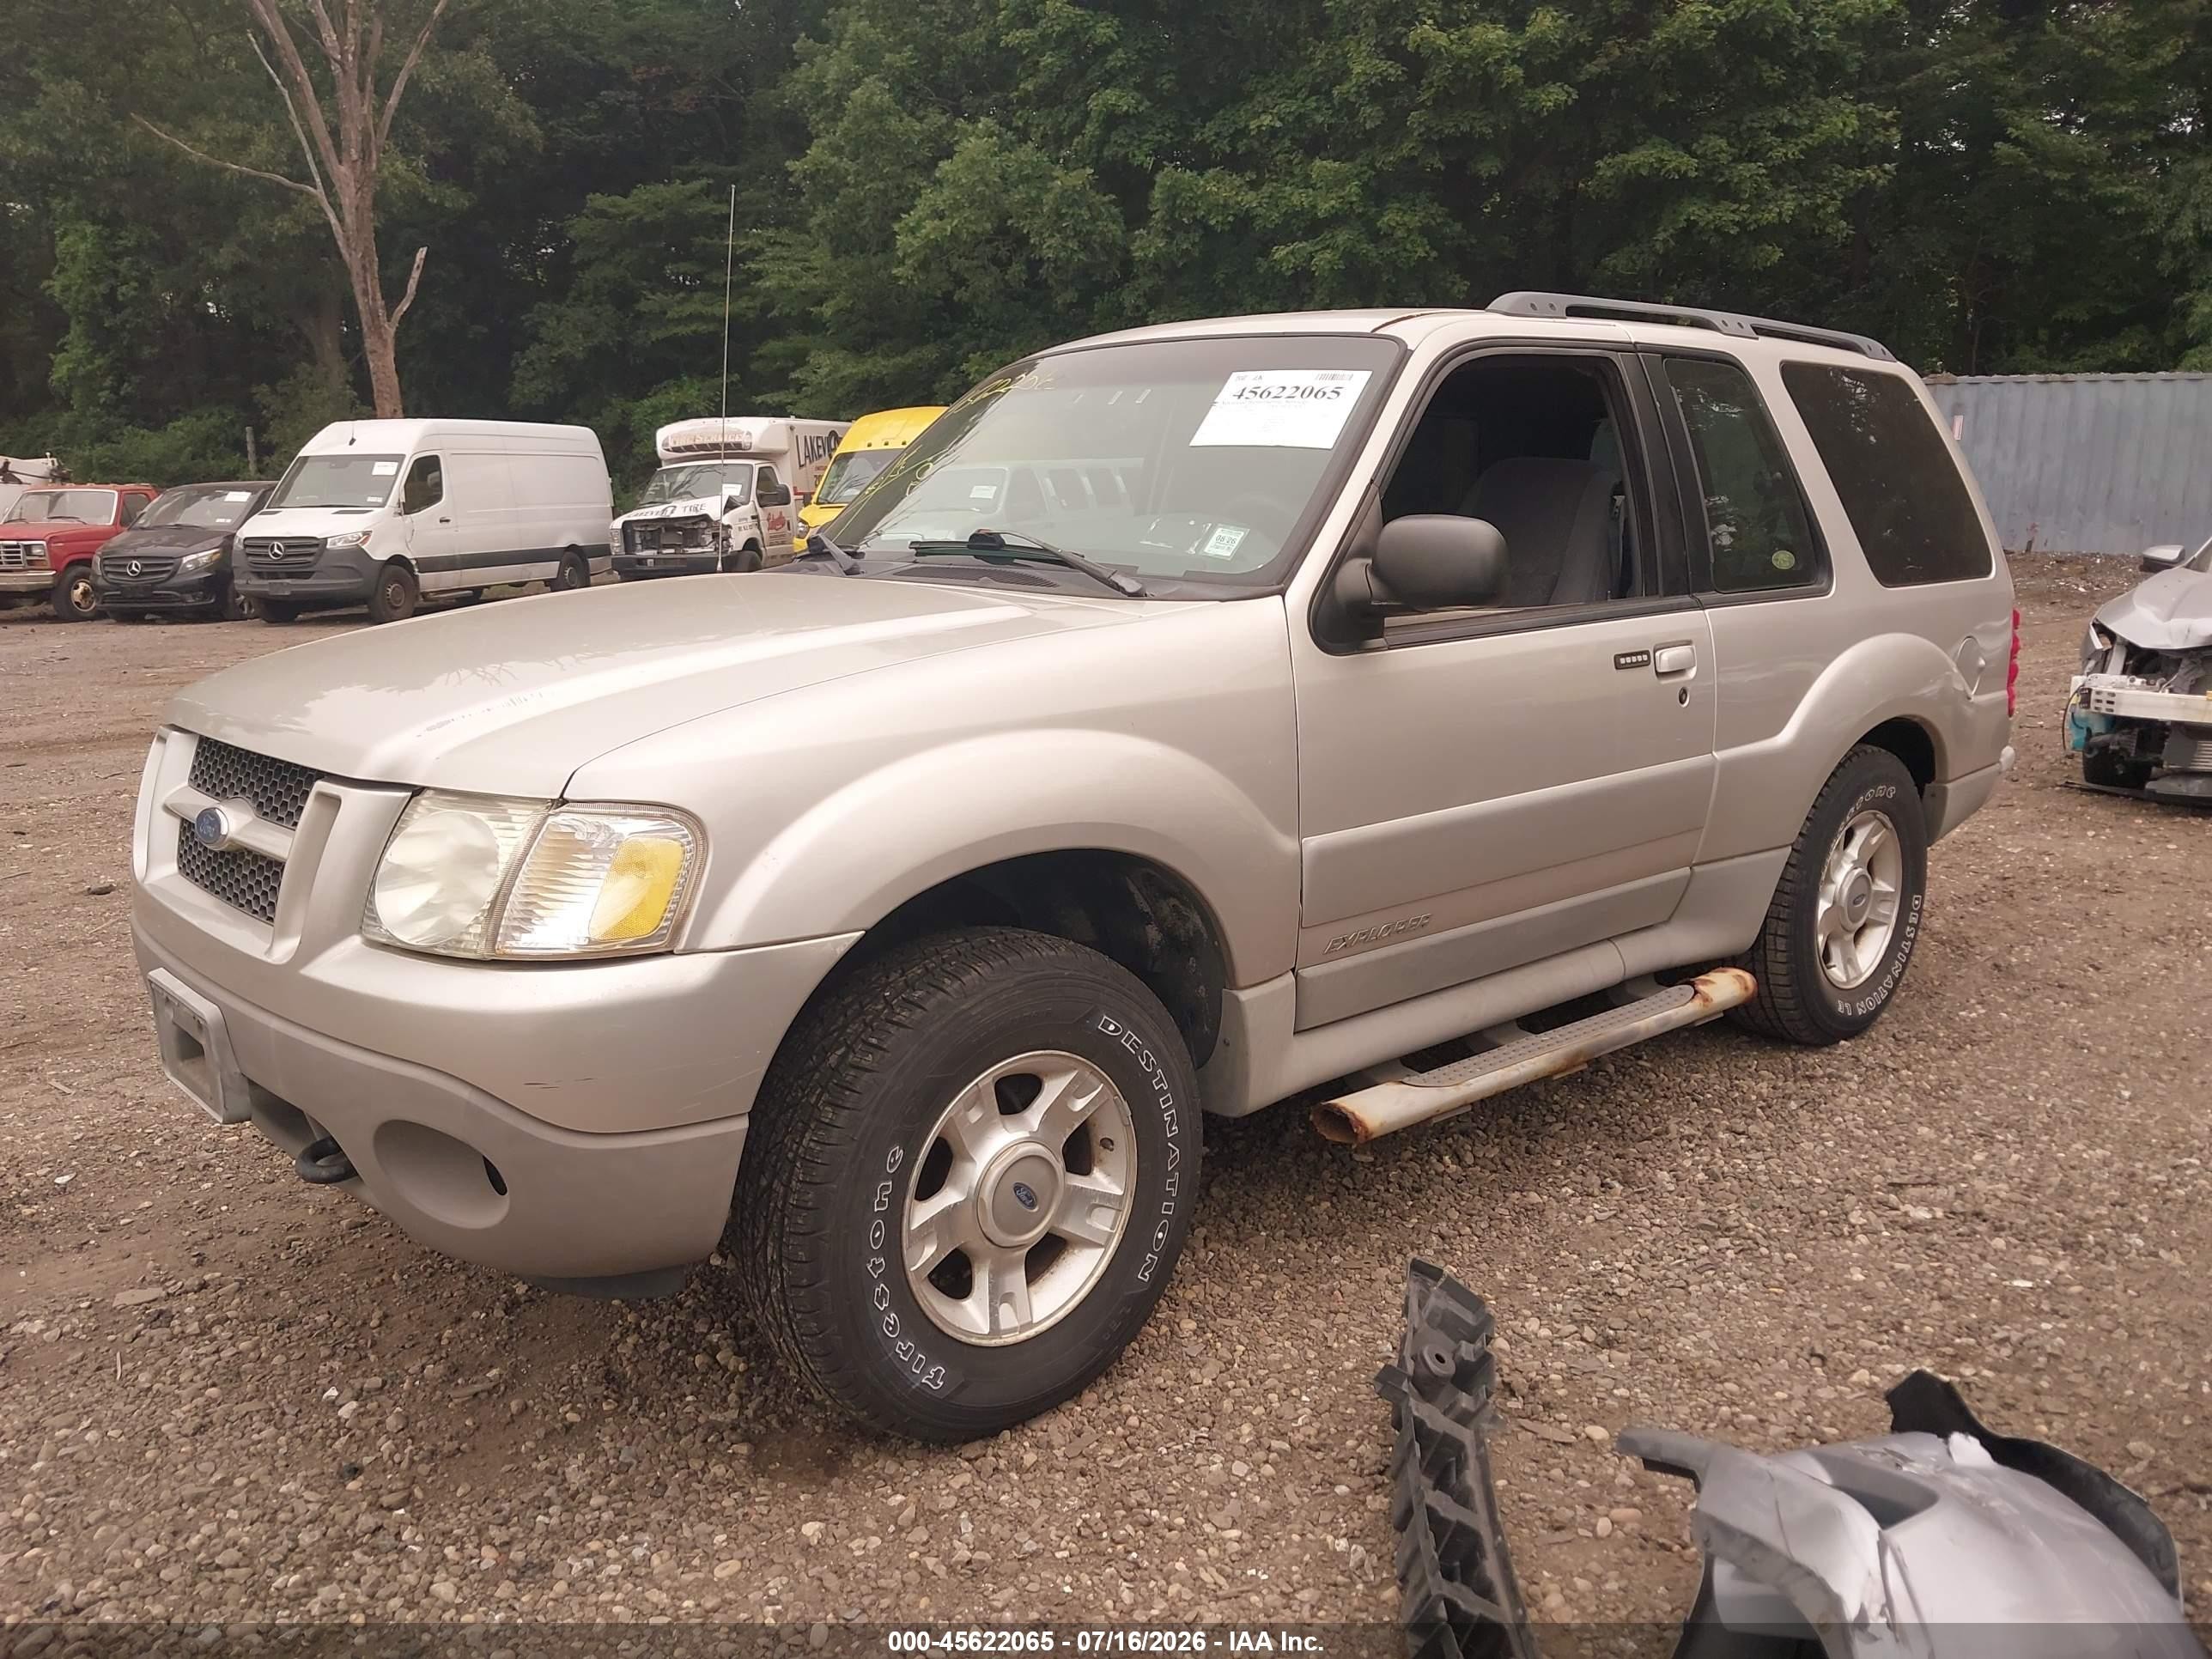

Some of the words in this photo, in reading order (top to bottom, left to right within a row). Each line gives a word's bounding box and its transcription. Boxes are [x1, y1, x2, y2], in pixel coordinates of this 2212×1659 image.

[1232, 385, 1344, 400] 45622065
[682, 503, 707, 513] TIRE
[1322, 913, 1433, 956] EXPLORER
[1856, 894, 1923, 1015] DESTINATION
[1097, 1015, 1180, 1283] DESTINATION
[867, 1145, 946, 1390] Firestone
